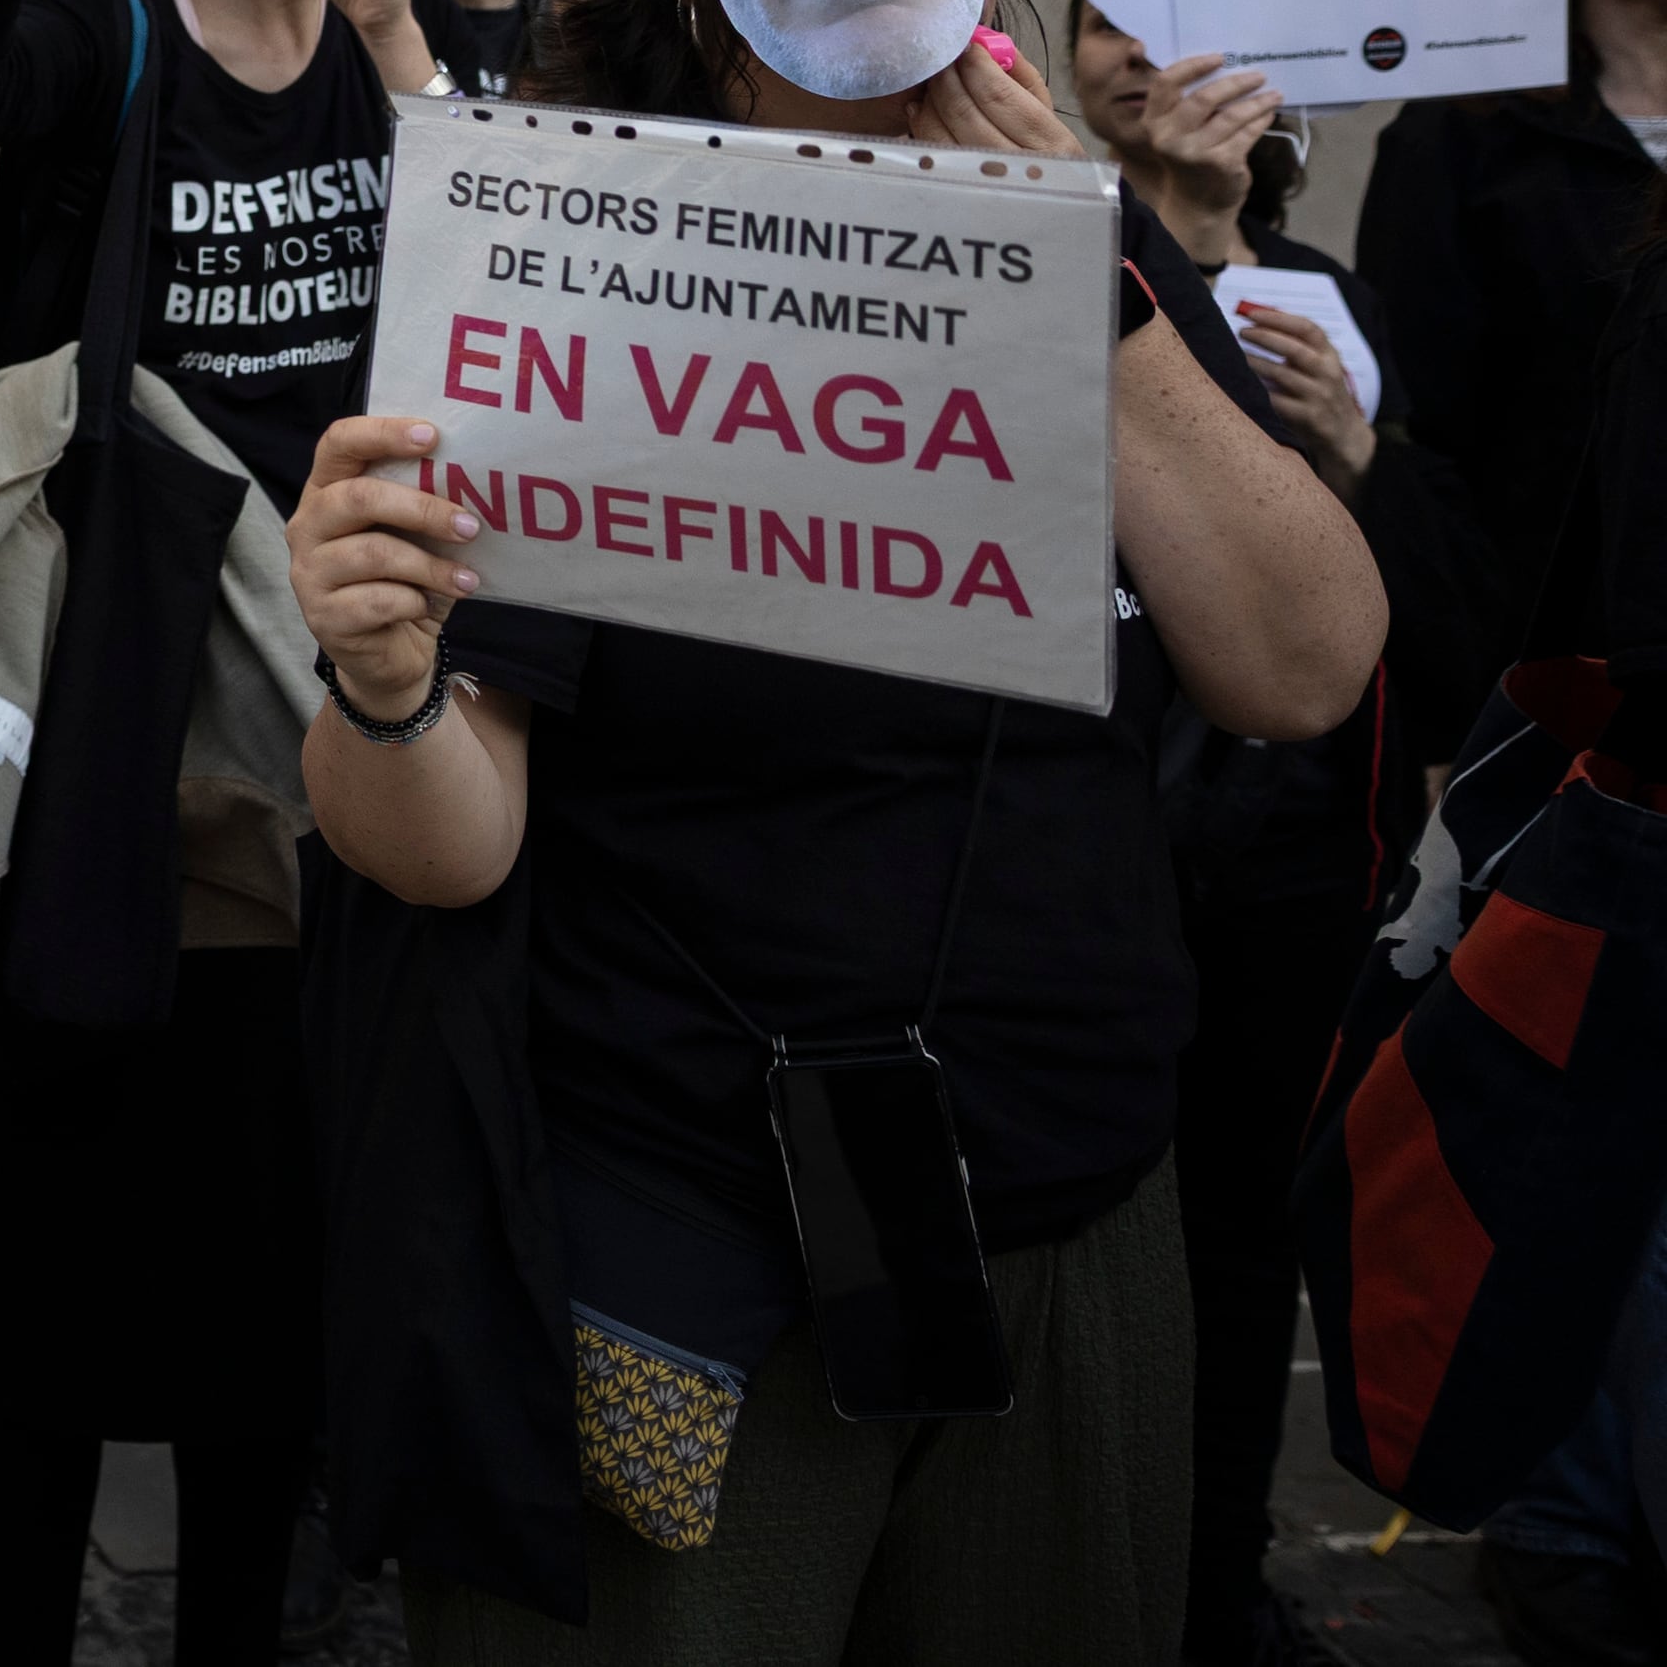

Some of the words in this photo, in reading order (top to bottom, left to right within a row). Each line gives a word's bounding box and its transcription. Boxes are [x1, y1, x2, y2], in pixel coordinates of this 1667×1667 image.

[449, 172, 658, 235] SECTORS
[677, 204, 1032, 283] FEMINITZATS
[489, 244, 545, 287] DE
[562, 257, 967, 346] L’AJUNTAMENT
[177, 334, 361, 378] #DefensemBiblios
[445, 314, 586, 422] EN
[630, 345, 1014, 482] VAGA
[419, 457, 1034, 619] INDEFINIDA
